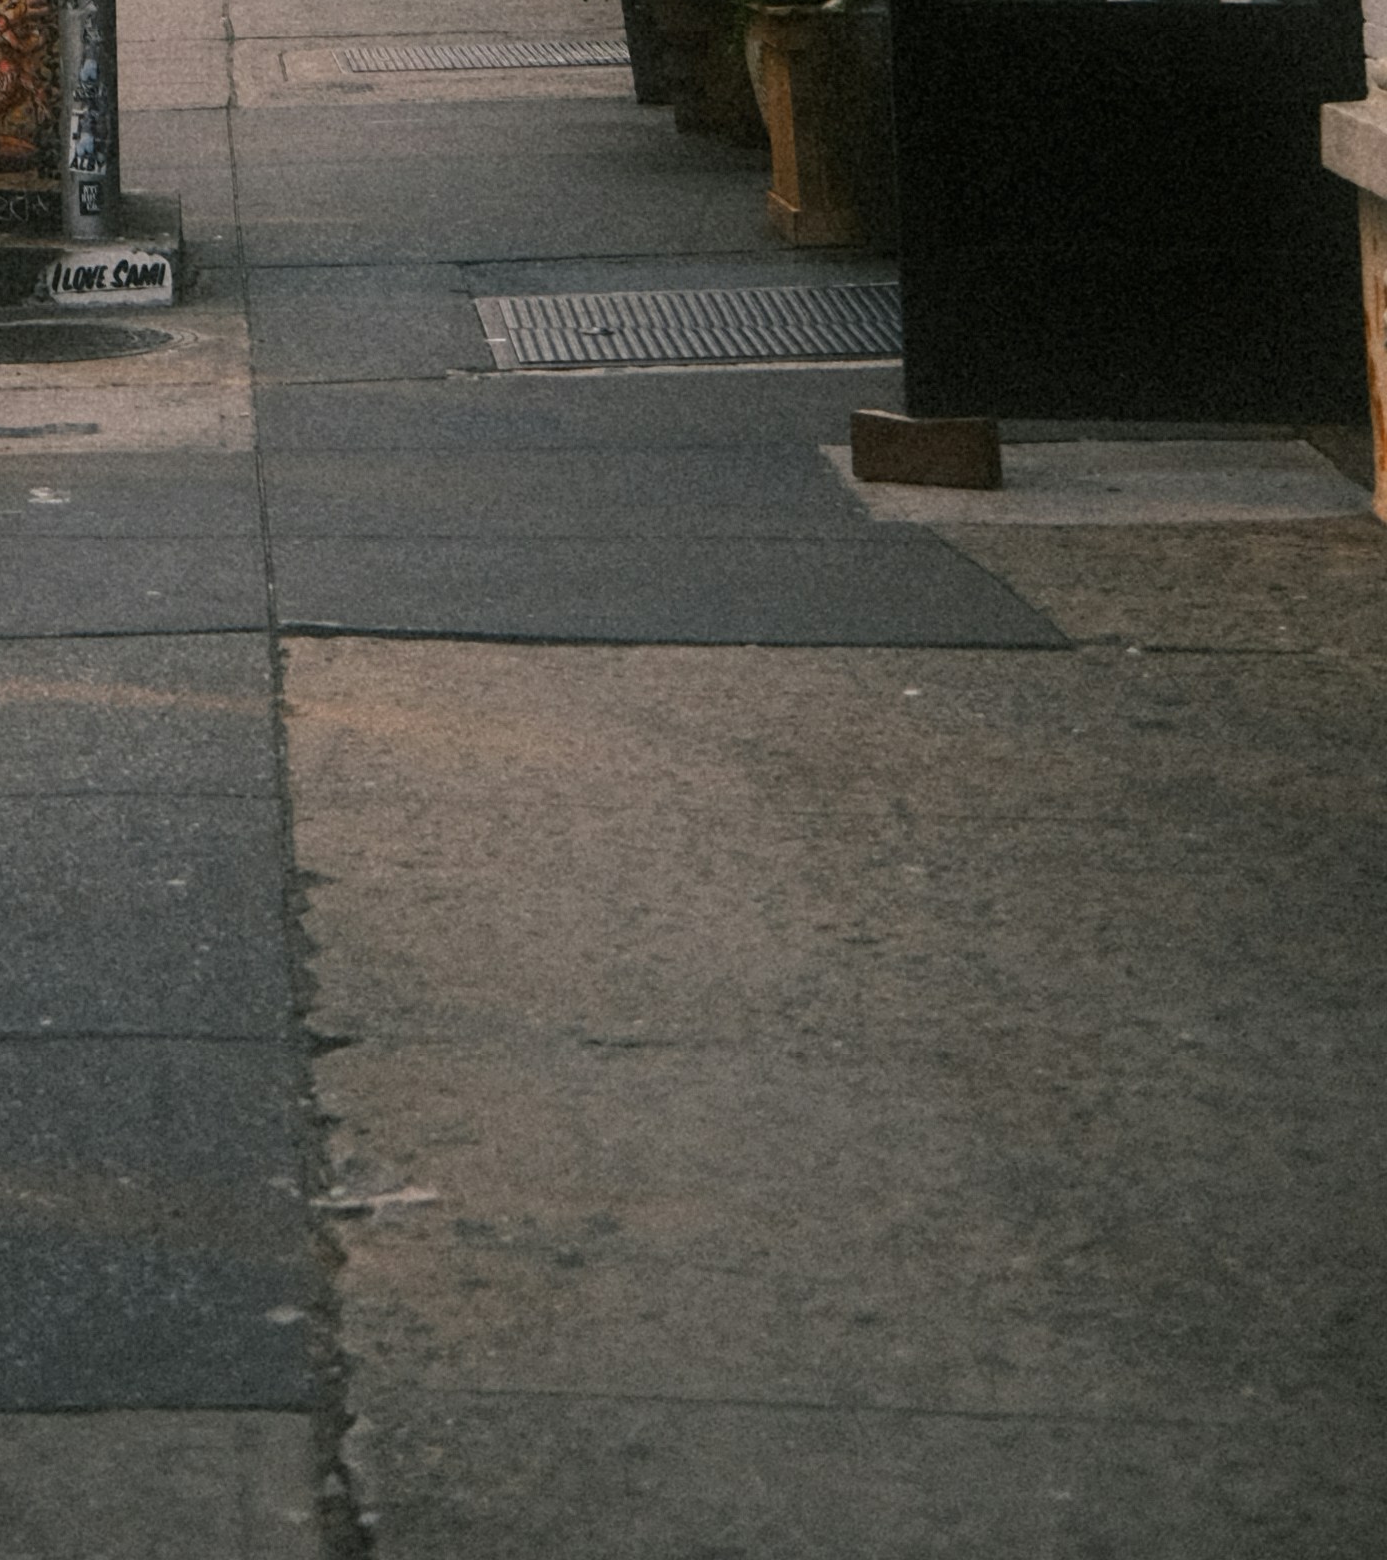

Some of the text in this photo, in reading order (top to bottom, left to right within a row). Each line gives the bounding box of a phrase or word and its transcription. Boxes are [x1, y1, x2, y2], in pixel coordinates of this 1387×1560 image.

[51, 259, 167, 293] I LOVE SAMI
